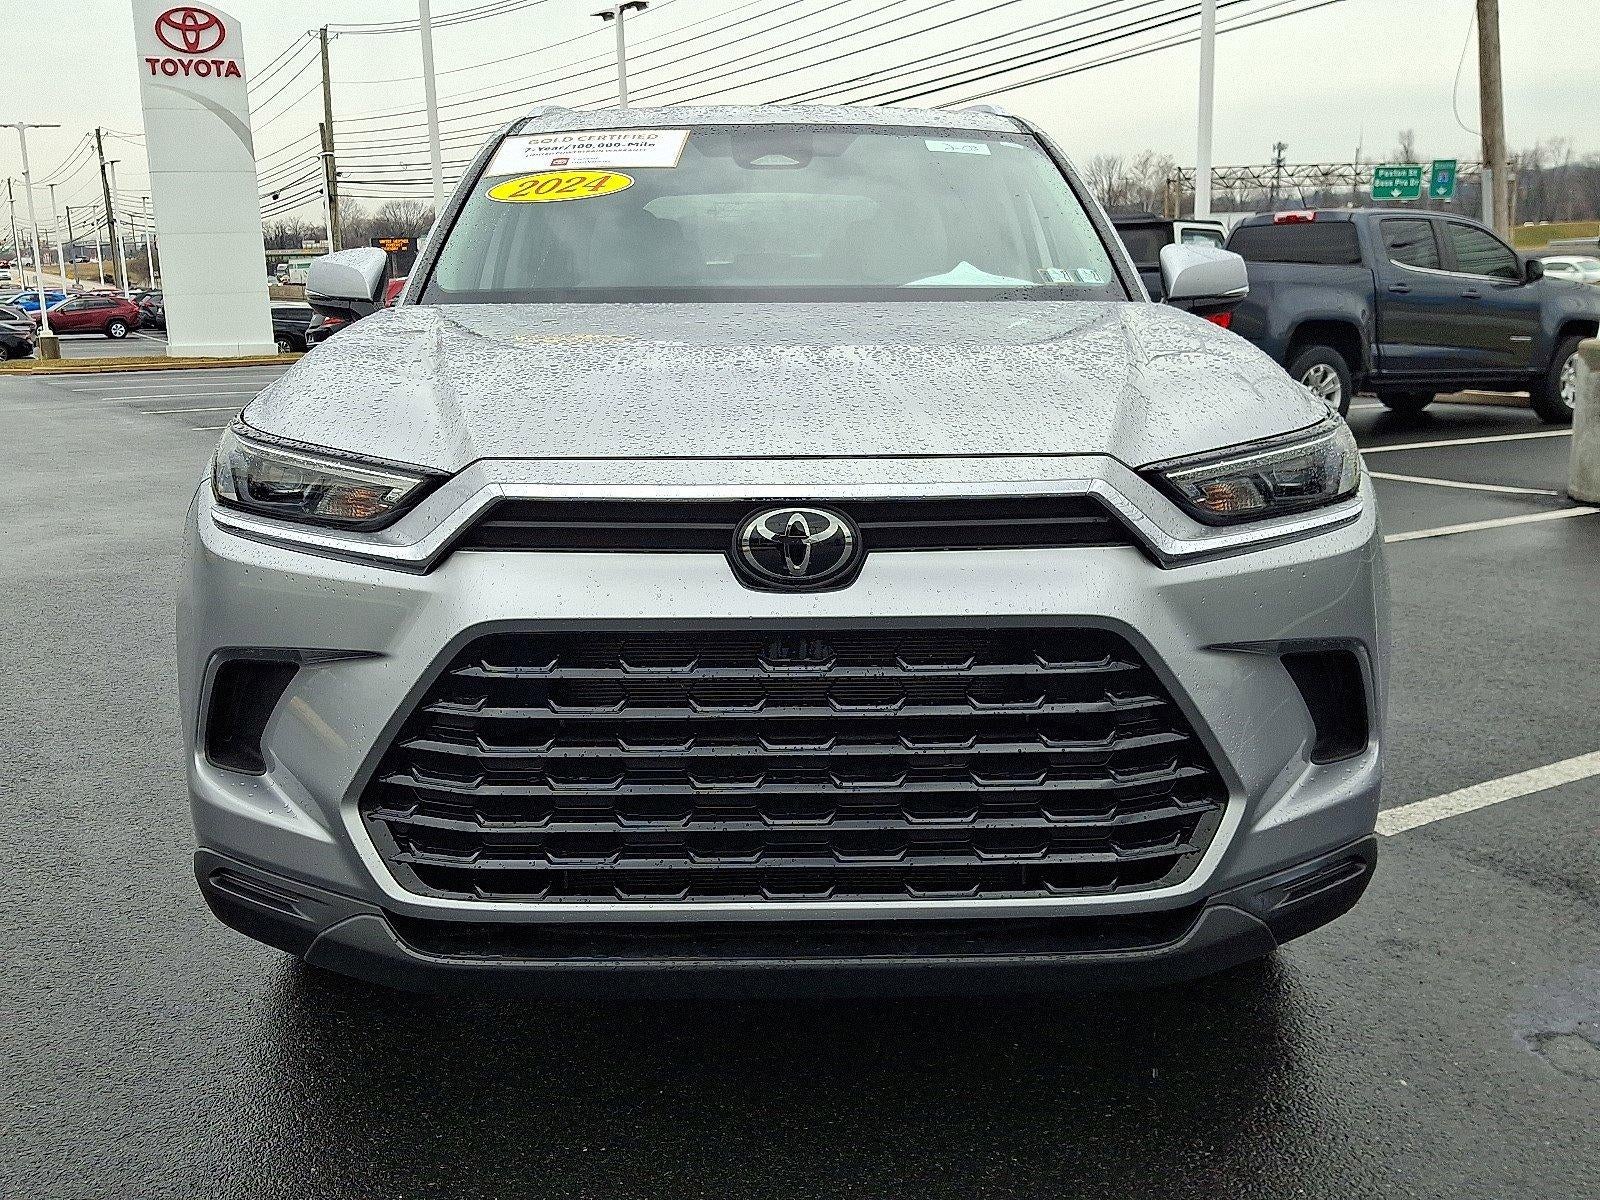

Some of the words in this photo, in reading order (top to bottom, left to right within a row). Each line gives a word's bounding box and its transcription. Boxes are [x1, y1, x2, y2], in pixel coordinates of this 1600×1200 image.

[145, 58, 241, 77] TOYOTA
[528, 136, 573, 145] GOLD
[577, 133, 659, 142] CERTIFIED
[509, 175, 611, 198] 2024
